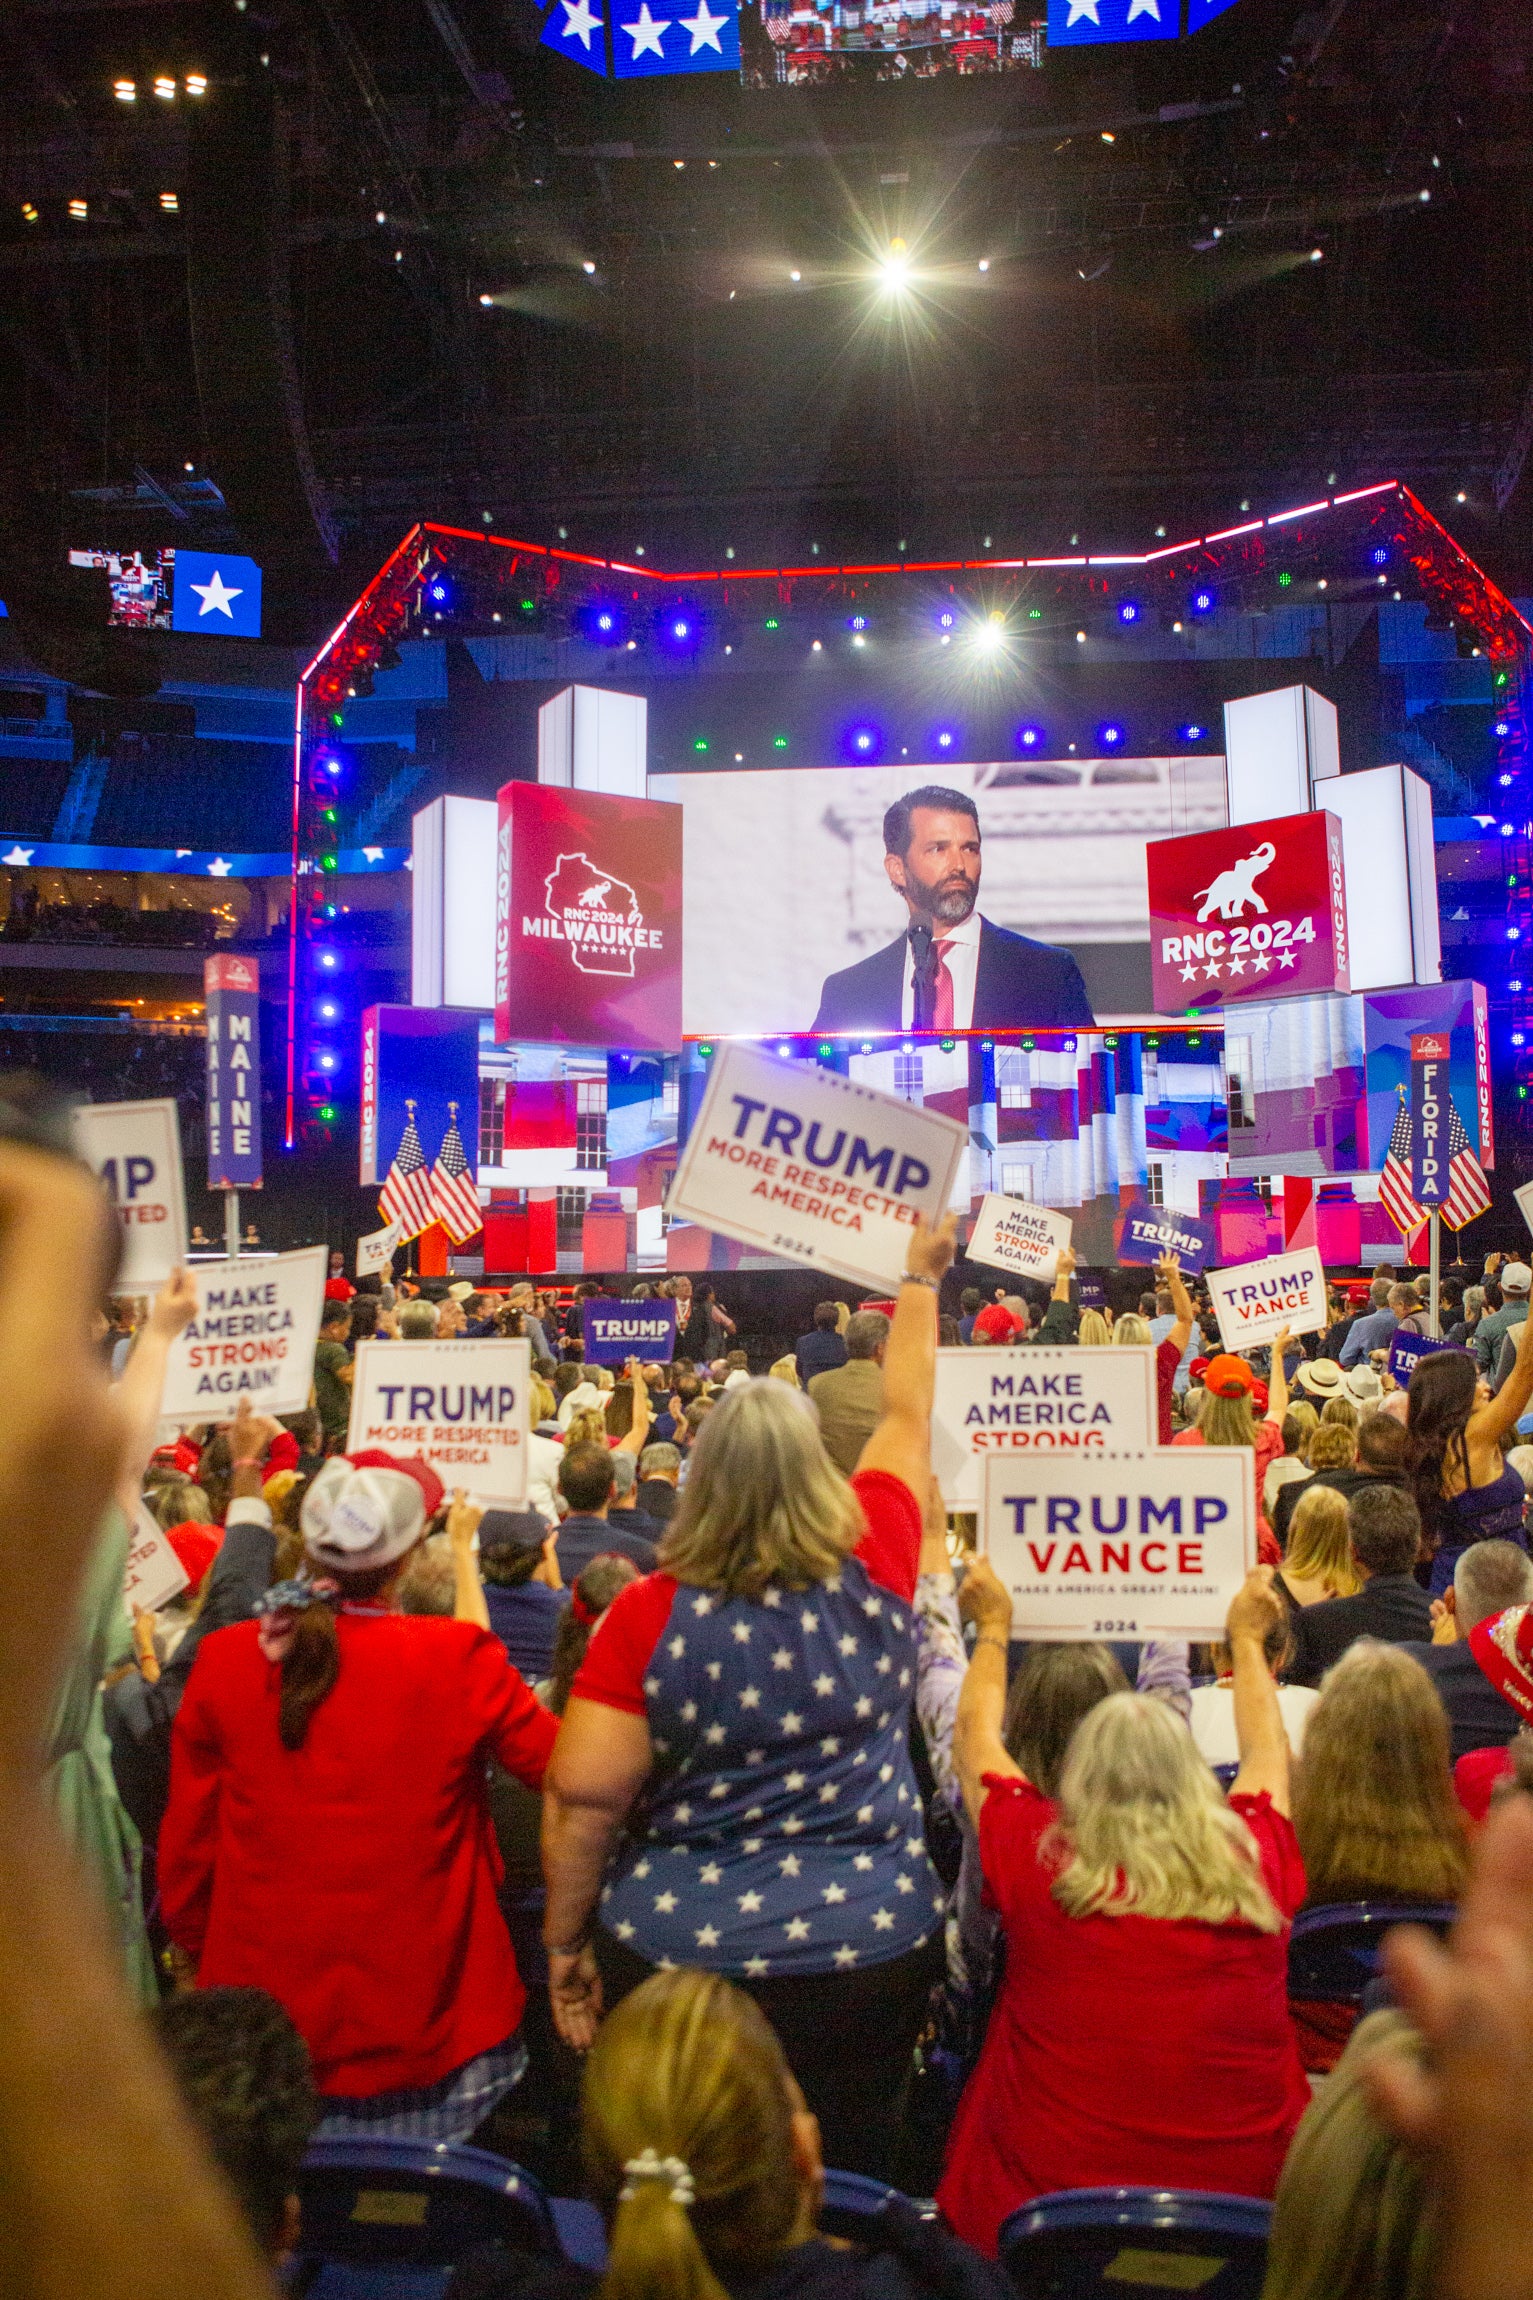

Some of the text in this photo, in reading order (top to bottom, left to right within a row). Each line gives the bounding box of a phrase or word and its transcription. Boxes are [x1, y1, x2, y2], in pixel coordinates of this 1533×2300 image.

[496, 815, 513, 1005] RNC 2024
[563, 907, 625, 924] RNC 2024
[1330, 835, 1347, 972] RNC 2024
[522, 916, 663, 949] MILWAUKEE
[1162, 916, 1317, 964] RNC 2024
[229, 1014, 252, 1155] MAINE
[1476, 1006, 1490, 1147] RNC 2024
[731, 1093, 931, 1196] TRUMP
[1421, 1064, 1439, 1195] FLORIDA
[707, 1137, 778, 1176] MORE
[751, 1178, 864, 1233] AMERICA
[1010, 1211, 1048, 1231] MAKE
[994, 1232, 1049, 1256] STRONG
[995, 1220, 1055, 1246] AMERICA
[1132, 1220, 1203, 1251] TRUMP
[994, 1245, 1042, 1266] AGAIN!
[206, 1283, 278, 1311] MAKE
[1222, 1270, 1314, 1306] TRUMP
[1237, 1291, 1310, 1320] VANCE
[183, 1309, 295, 1342] AMERICA
[591, 1320, 670, 1336] TRUMP
[189, 1337, 289, 1369] STRONG
[991, 1374, 1083, 1397] MAKE
[378, 1385, 515, 1422] TRUMP
[965, 1402, 1112, 1425] AMERICA
[367, 1426, 521, 1446] MORE RESPECTED
[1002, 1497, 1229, 1535] TRUMP
[1028, 1541, 1204, 1575] VANCE
[1093, 1621, 1138, 1633] 2024
